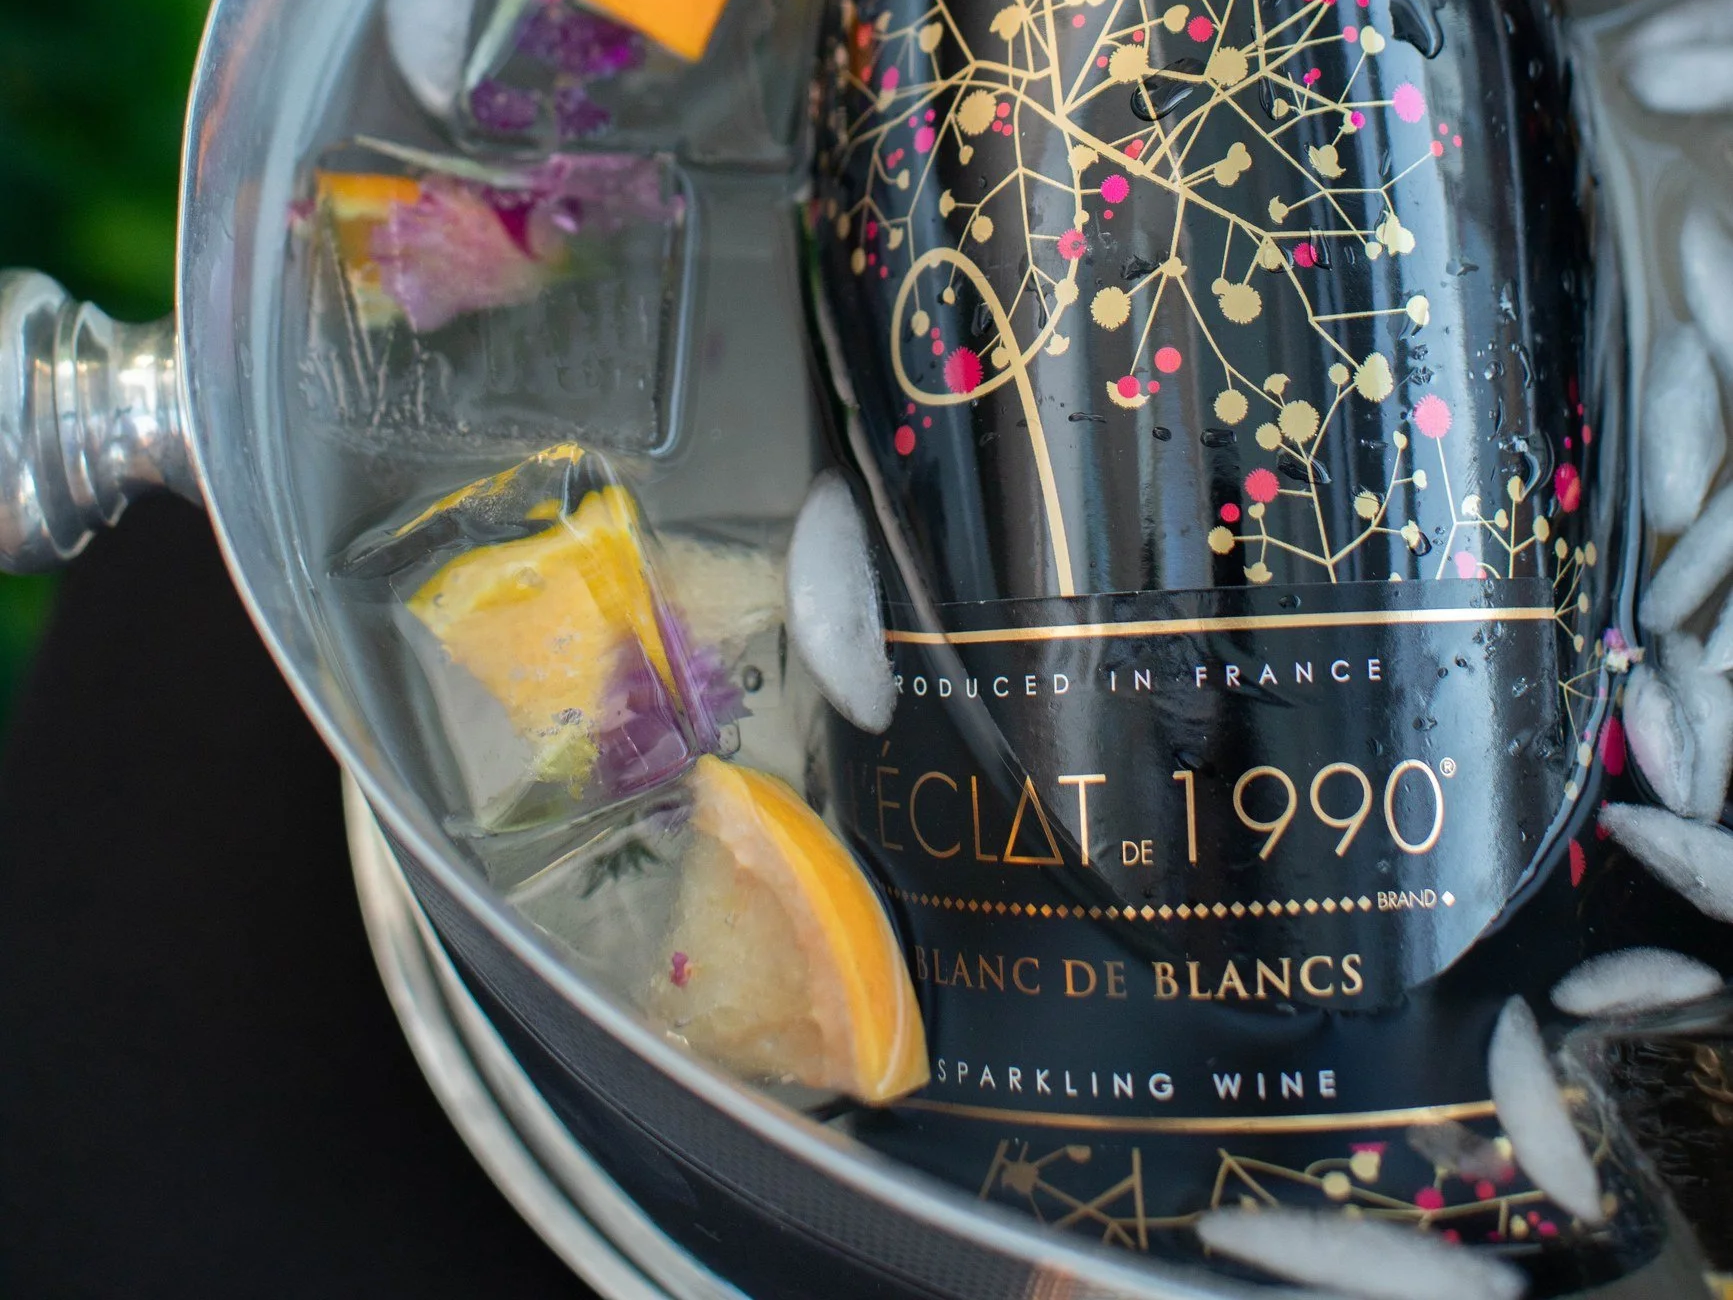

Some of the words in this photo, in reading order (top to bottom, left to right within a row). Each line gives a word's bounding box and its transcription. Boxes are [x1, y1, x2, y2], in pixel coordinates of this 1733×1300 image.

[894, 673, 1071, 699] RODUCED
[1110, 668, 1152, 693] IN
[1195, 658, 1382, 688] FRANCE
[1122, 839, 1154, 865] DE
[1376, 888, 1437, 909] BRAND
[917, 945, 1041, 994] BLANC
[1063, 957, 1126, 998] DE
[1153, 952, 1364, 1001] BLANCS
[937, 1057, 1175, 1100] SPARKLING
[1213, 1069, 1338, 1098] WINE
